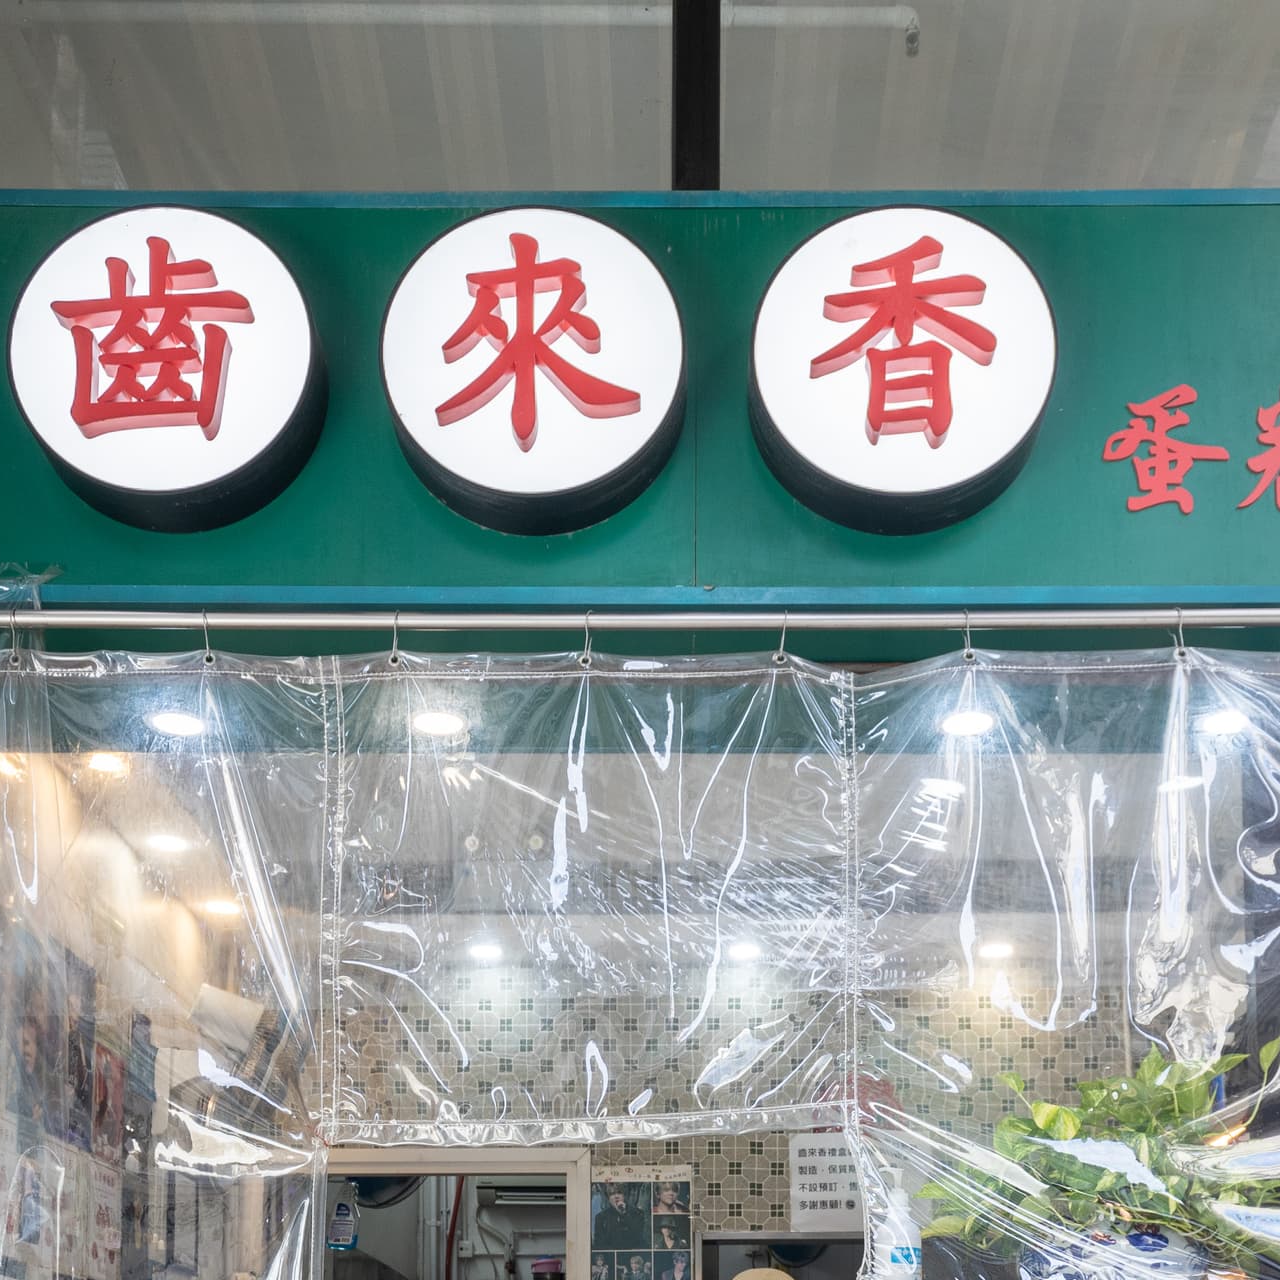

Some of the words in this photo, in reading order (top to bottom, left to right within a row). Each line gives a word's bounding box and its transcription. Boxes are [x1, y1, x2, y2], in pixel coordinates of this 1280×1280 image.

[798, 1147, 851, 1158] 齒來香禮盒
